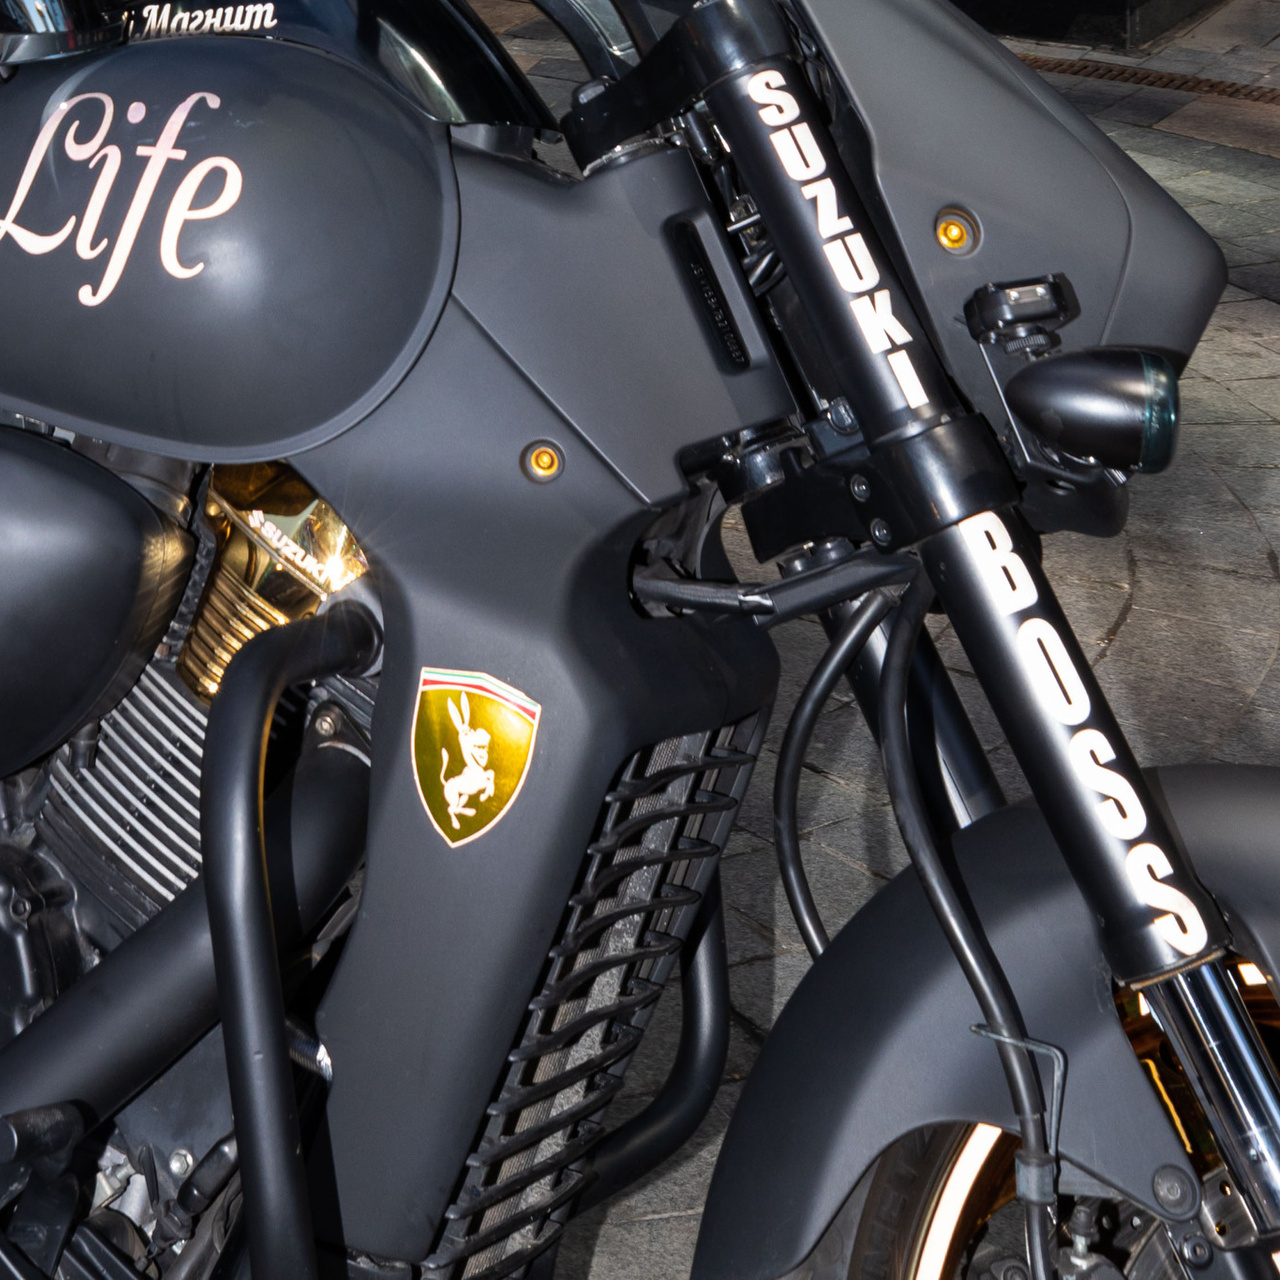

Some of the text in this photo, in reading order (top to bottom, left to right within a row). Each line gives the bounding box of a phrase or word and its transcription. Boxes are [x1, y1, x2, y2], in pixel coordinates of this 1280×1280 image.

[746, 68, 928, 409] SUZUKI
[261, 520, 348, 590] SUZUK
[958, 509, 1209, 956] BOSS
